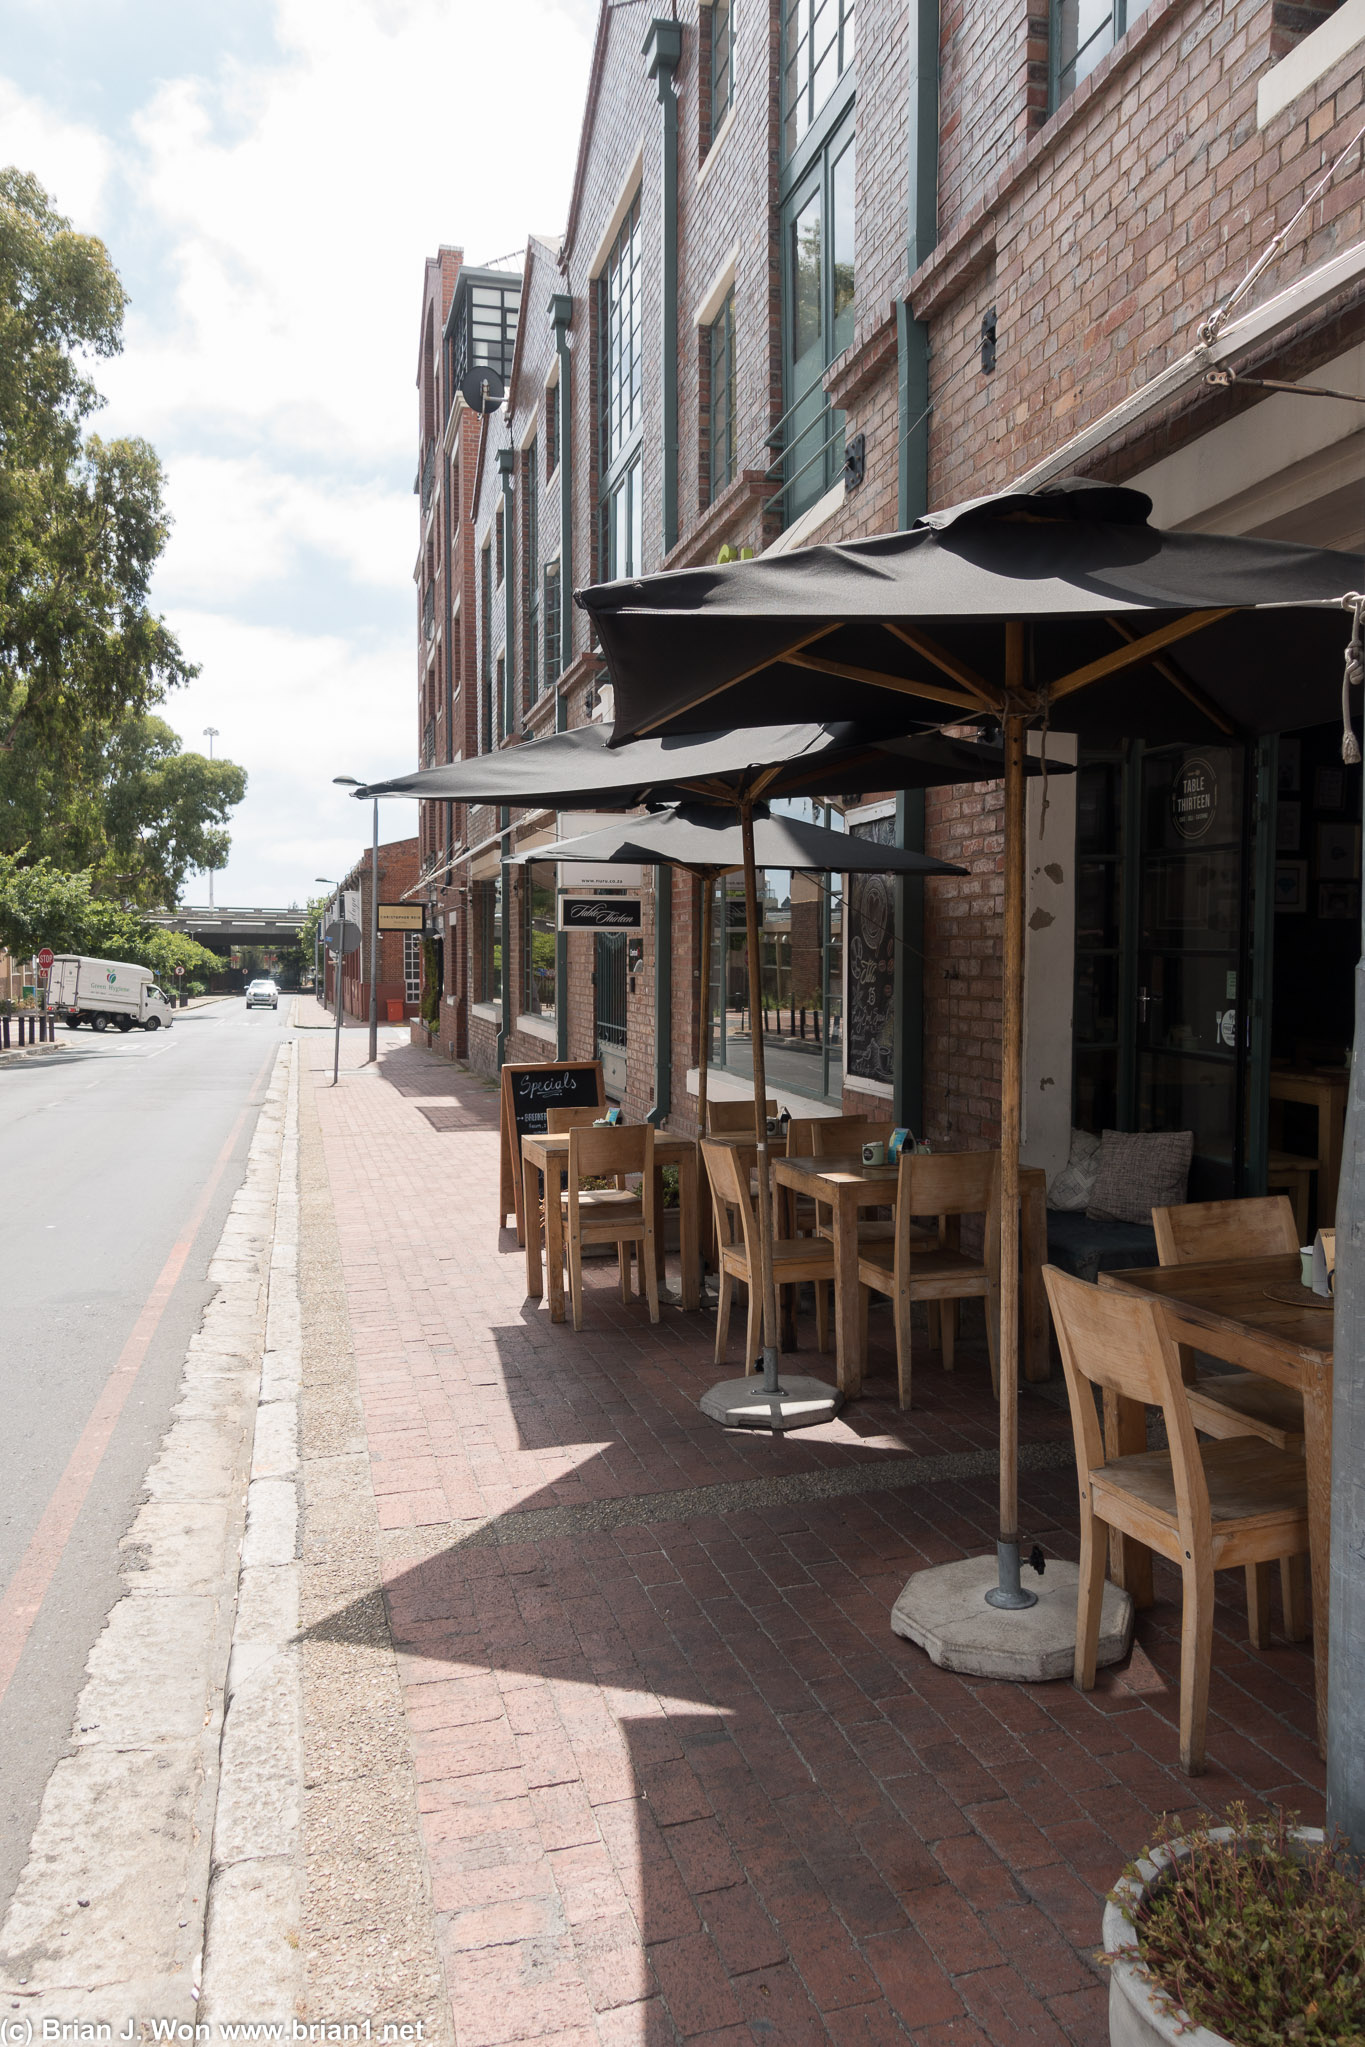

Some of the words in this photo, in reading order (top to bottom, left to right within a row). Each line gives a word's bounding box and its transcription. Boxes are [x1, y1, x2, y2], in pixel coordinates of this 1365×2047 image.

[1183, 776, 1205, 793] TABLE
[1177, 793, 1210, 813] THIRTEEN
[570, 902, 607, 918] Table
[596, 910, 634, 924] Thirteen
[40, 954, 53, 964] STOP
[91, 982, 106, 990] Green
[108, 984, 130, 993] Hygiene
[519, 1071, 577, 1099] Specials
